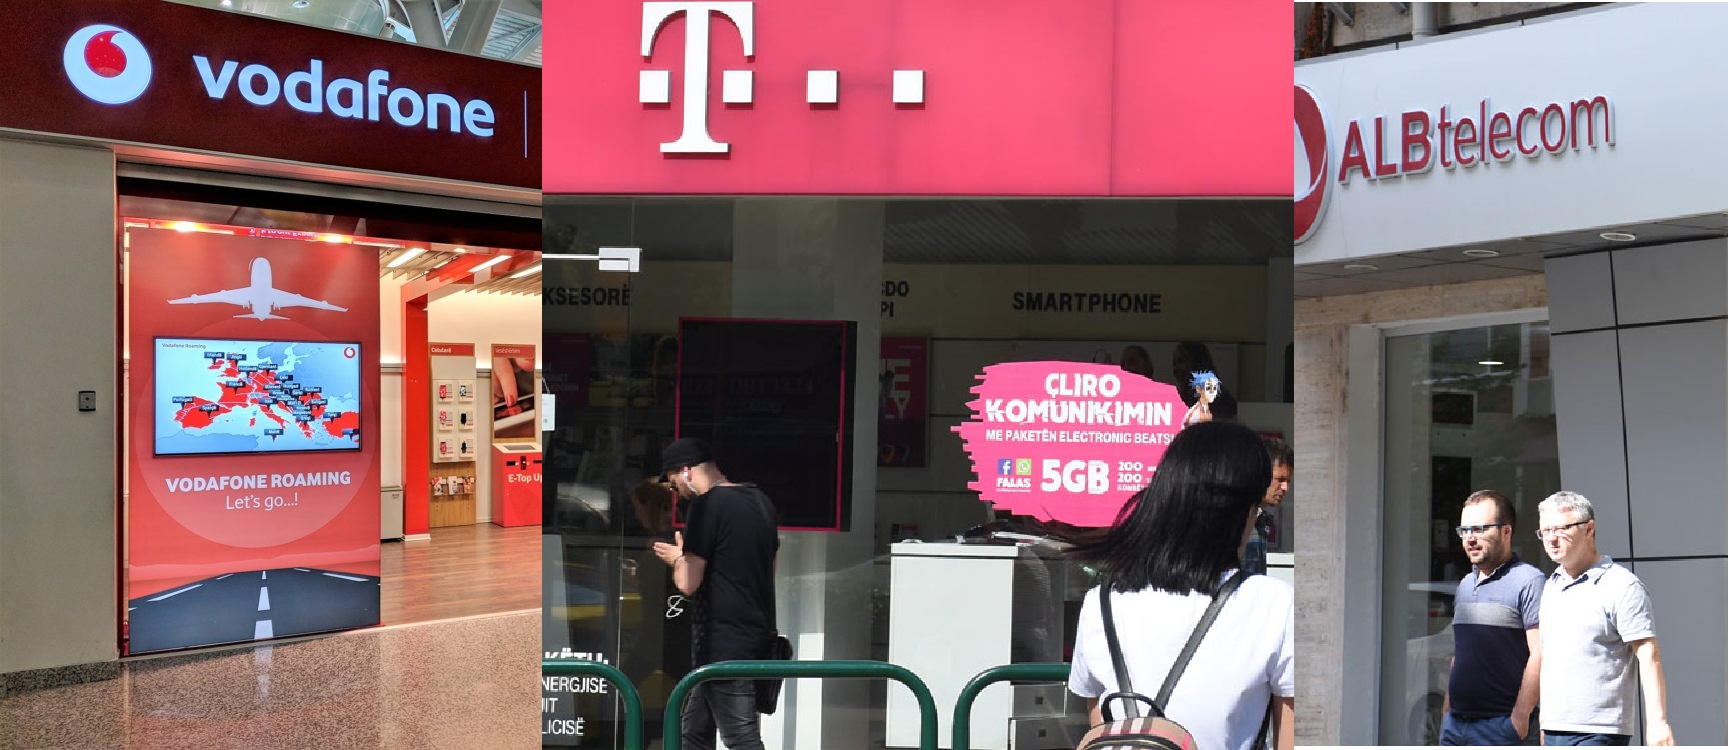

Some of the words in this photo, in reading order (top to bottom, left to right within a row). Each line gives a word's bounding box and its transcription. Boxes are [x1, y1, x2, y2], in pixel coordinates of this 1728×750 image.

[640, 1, 755, 154] T
[192, 55, 496, 138] vodafone
[1338, 95, 1616, 187] ALBtelecom
[881, 280, 910, 297] DO
[1012, 291, 1162, 314] SMARTPHONE
[1045, 372, 1121, 398] ÇLIRO
[985, 398, 1173, 427] KOMUNIKIMIN
[986, 429, 1003, 442] ME
[1005, 428, 1057, 443] PAKETËN
[1059, 430, 1132, 444] ELECTRONIC
[1041, 459, 1110, 494] 5GB
[1118, 461, 1143, 471] 200
[165, 474, 268, 493] VODAFONE
[271, 471, 351, 488] ROAMING
[508, 472, 532, 484] E-Top
[997, 477, 1031, 488] FALAS
[1117, 473, 1143, 483] 200
[226, 495, 261, 510] Let's
[264, 492, 298, 511] go...!
